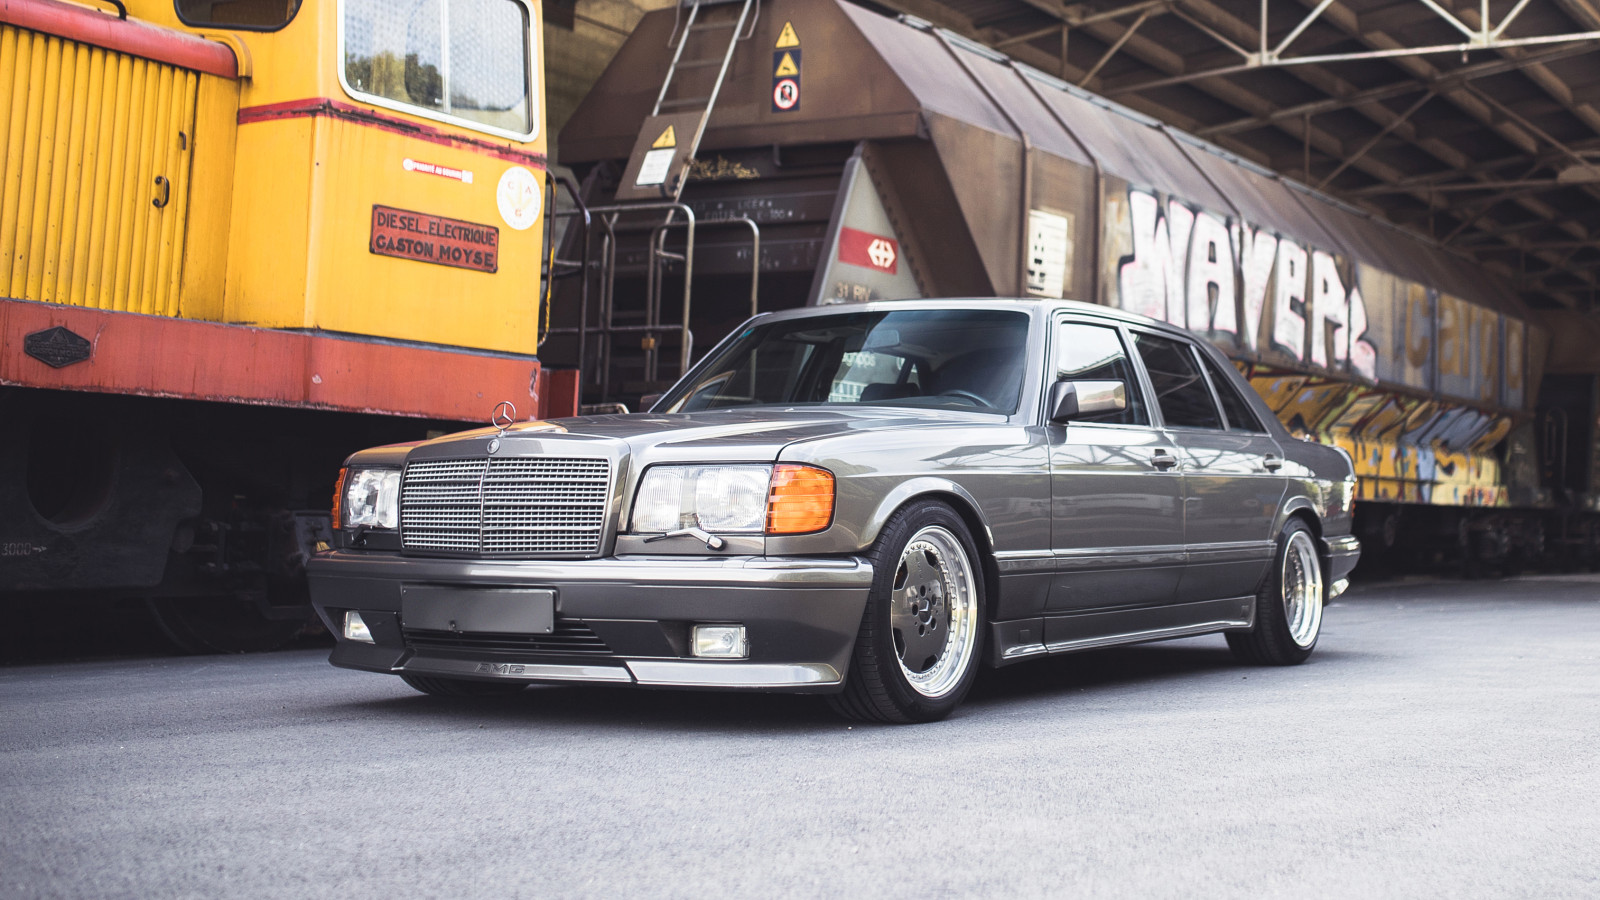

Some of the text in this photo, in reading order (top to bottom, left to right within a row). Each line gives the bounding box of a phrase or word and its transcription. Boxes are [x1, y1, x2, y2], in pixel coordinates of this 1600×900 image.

[375, 234, 494, 268] GASTON MOYSE
[837, 282, 849, 298] 31
[474, 663, 526, 675] AMG
